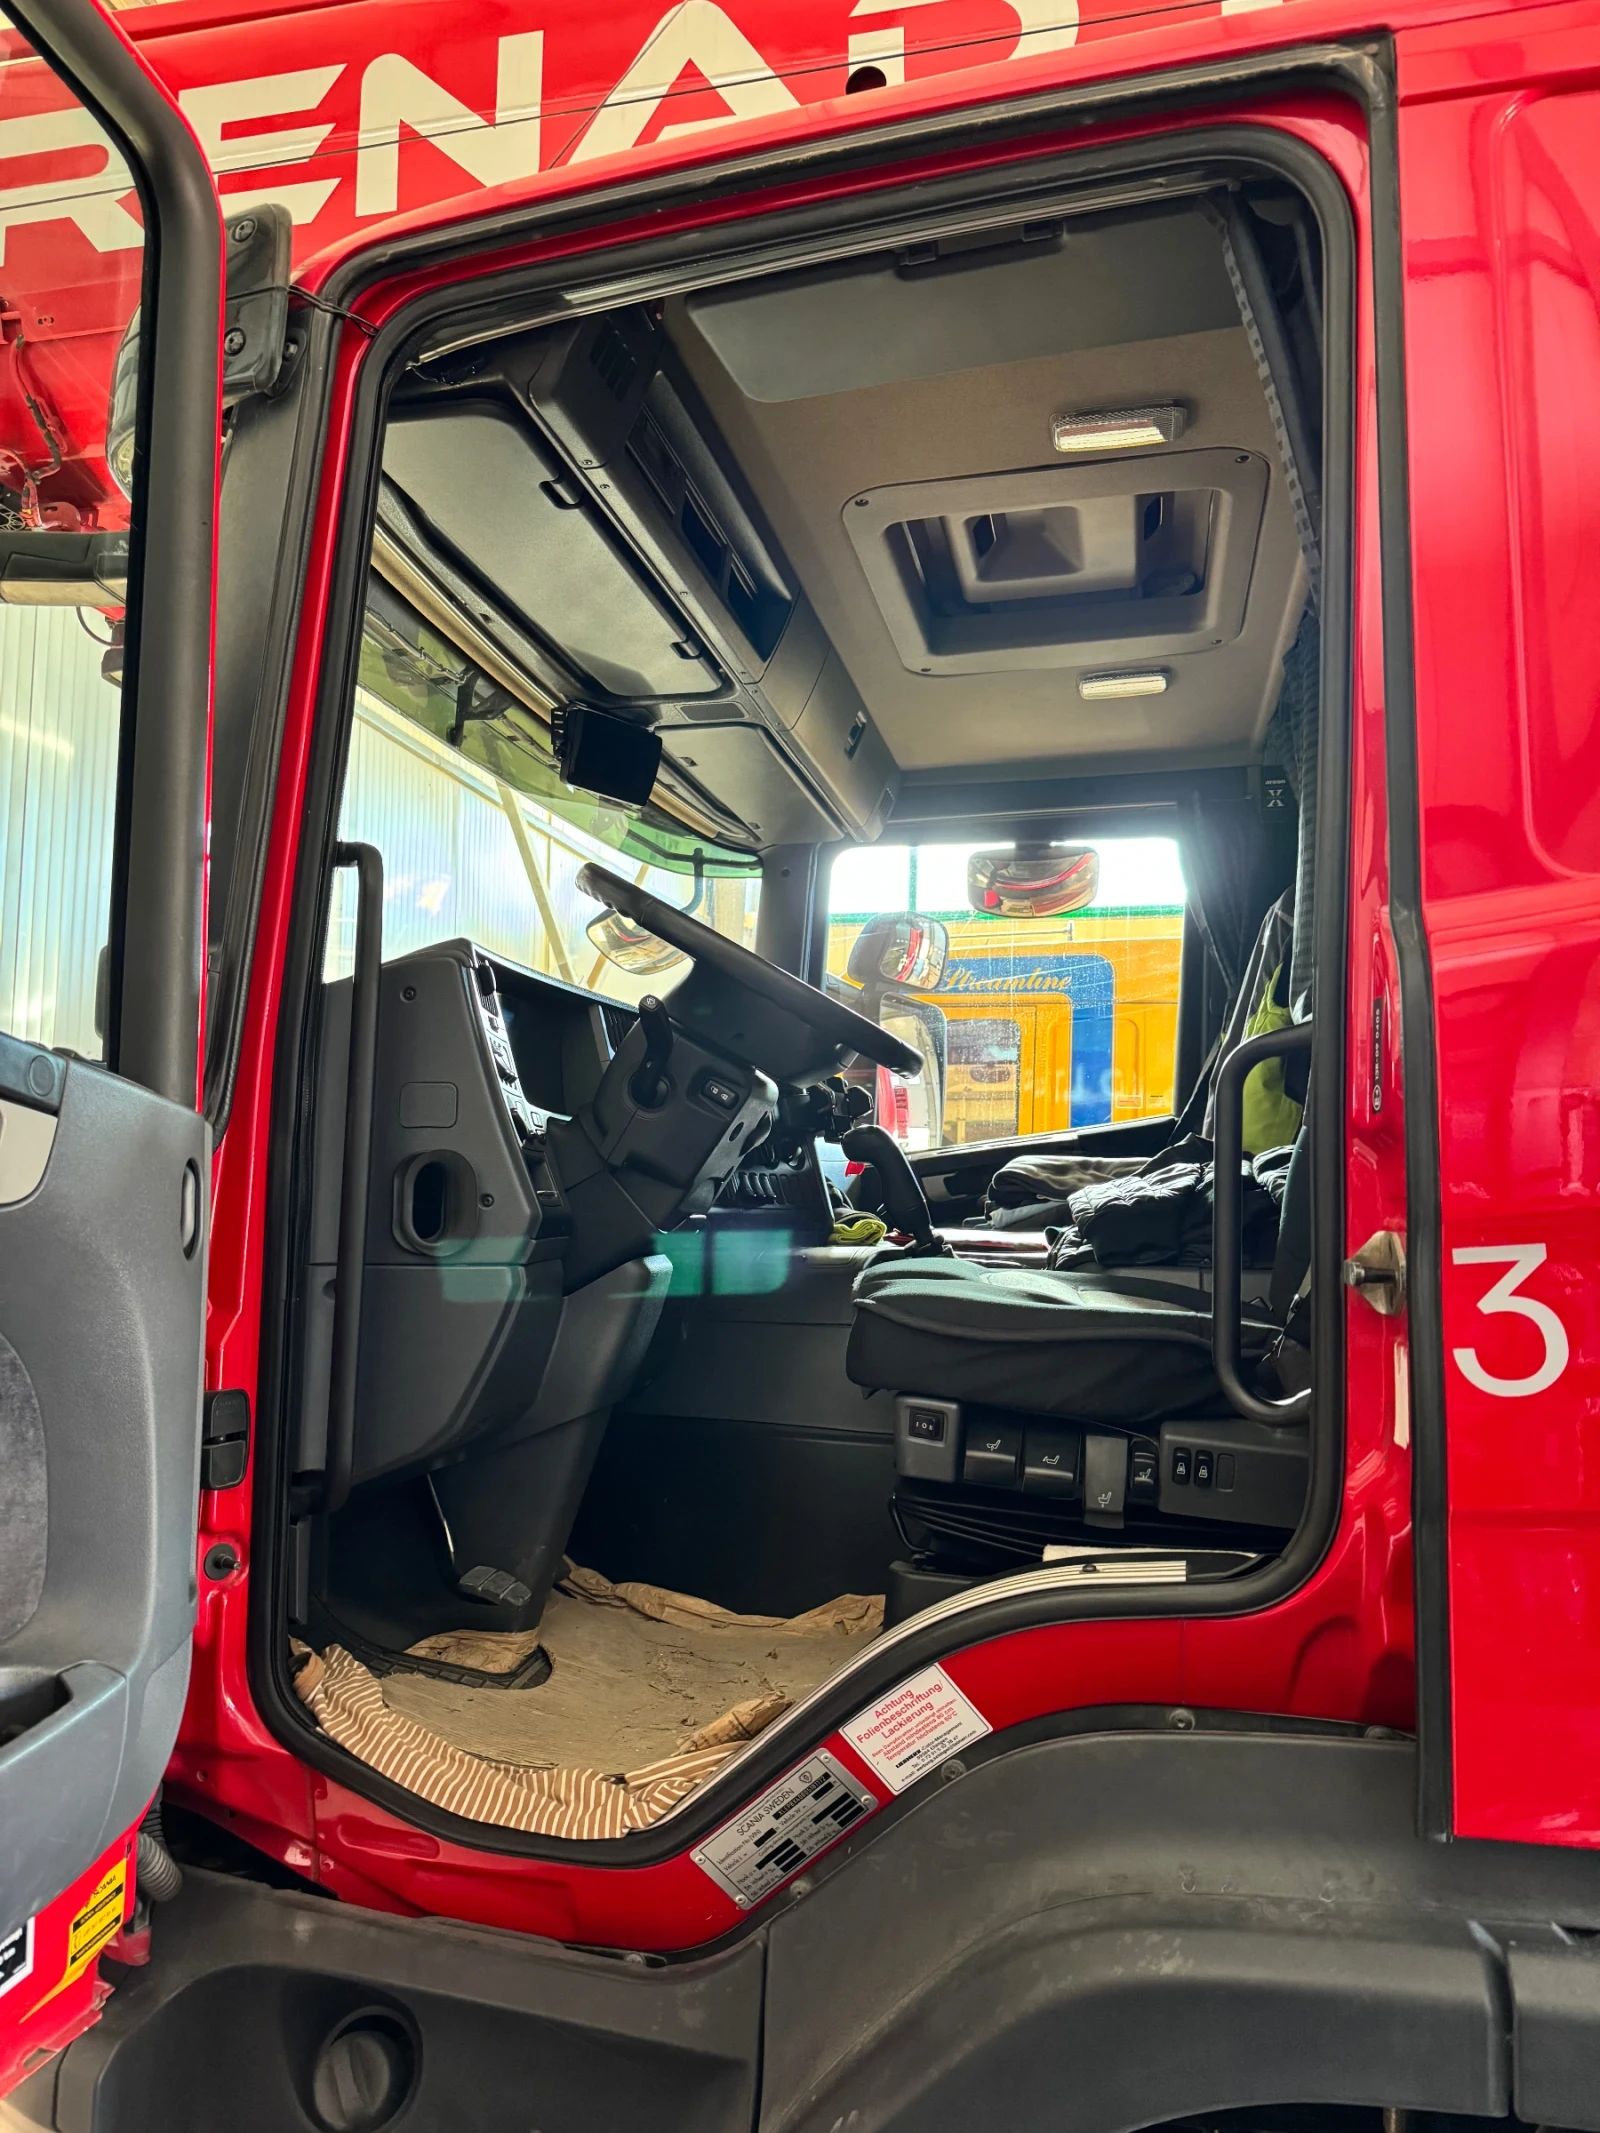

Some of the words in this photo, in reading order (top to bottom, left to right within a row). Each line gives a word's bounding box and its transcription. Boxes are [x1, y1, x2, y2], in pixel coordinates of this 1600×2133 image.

[943, 967, 1072, 992] Streamline
[1453, 1243, 1569, 1397] 3
[857, 1680, 944, 1743] Folienbeschriftung/
[875, 1690, 914, 1718] Achtung
[881, 1702, 934, 1738] Lackierung
[883, 1739, 905, 1756] Abstand
[906, 1719, 936, 1740] mindestens
[886, 1740, 916, 1760] Temperatur
[916, 1721, 944, 1740] höchstens
[737, 1813, 764, 1835] SCANIA
[763, 1788, 794, 1814] SWEDEN
[779, 1814, 796, 1826] Vehicle
[717, 1845, 742, 1864] Identification
[724, 1859, 739, 1870] Vehicle
